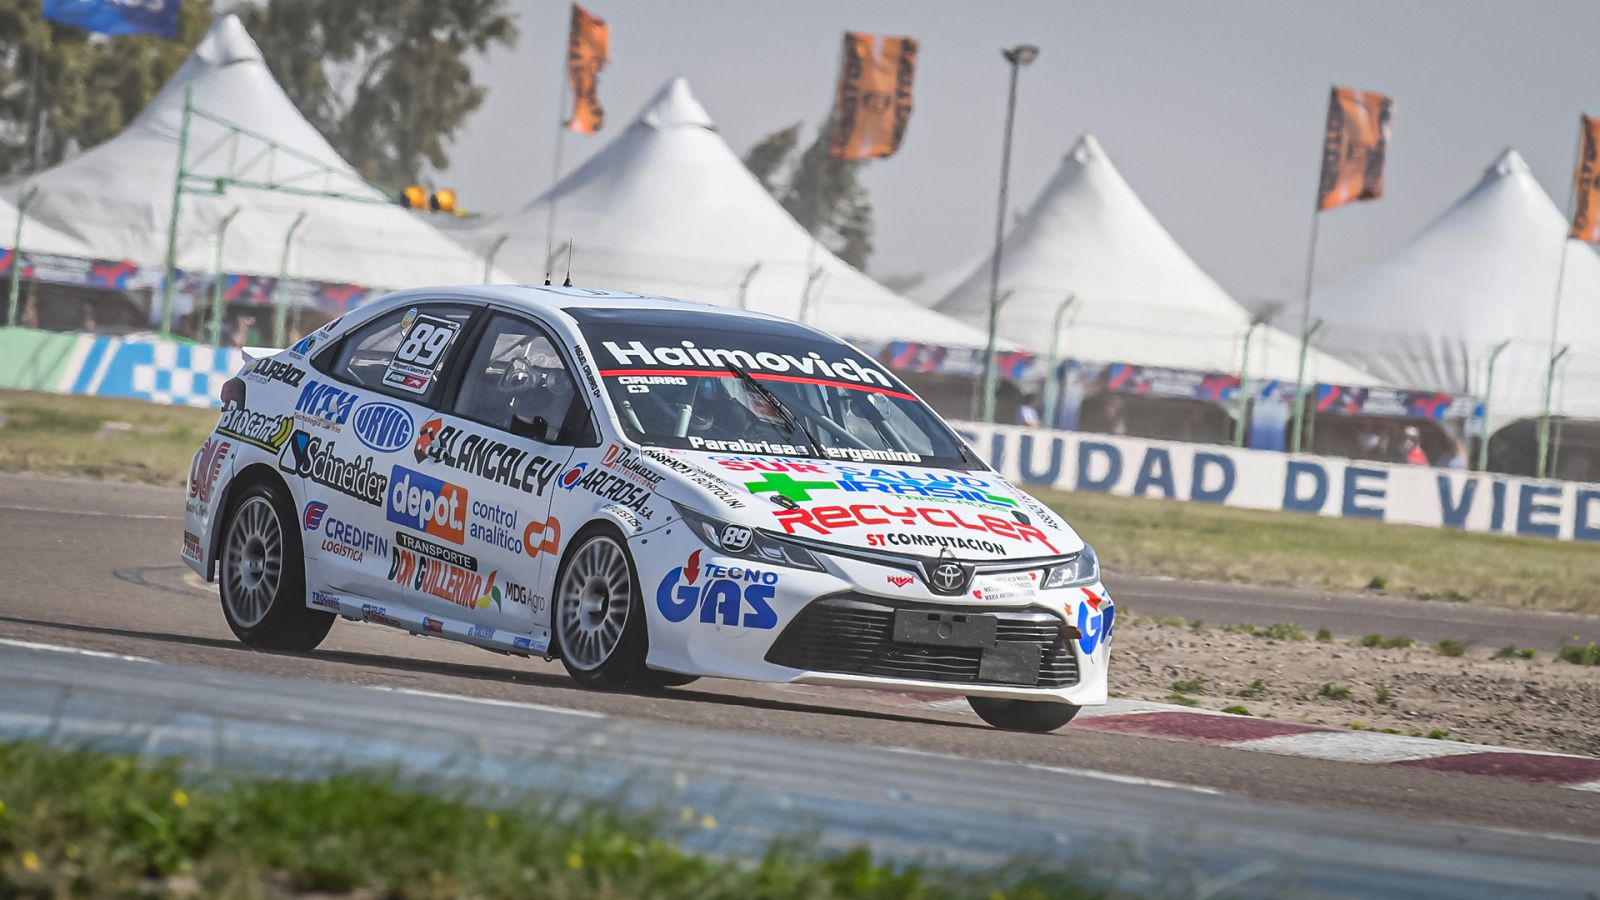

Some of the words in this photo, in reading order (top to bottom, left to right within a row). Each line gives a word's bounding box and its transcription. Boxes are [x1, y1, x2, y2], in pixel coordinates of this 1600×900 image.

[398, 323, 453, 365] 89
[602, 340, 893, 388] Haimovich
[627, 385, 650, 393] C3
[356, 403, 409, 447] URVIG
[434, 425, 560, 496] BLANCALEY
[615, 446, 666, 483] Dalmazzo
[688, 436, 810, 456] Parabrisas
[300, 437, 387, 501] Schneider
[717, 460, 830, 475] SUR
[834, 466, 991, 488] SALUD
[958, 428, 1238, 506] IUDAD
[1282, 461, 1389, 519] DE
[577, 468, 651, 513] ARCROSA
[472, 501, 518, 530] control
[325, 517, 388, 559] CREDIFIN
[401, 535, 471, 568] TRANSPORTE
[470, 522, 523, 554] analítico
[722, 527, 751, 548] 89
[387, 546, 415, 588] DON
[414, 556, 482, 610] GUILLERMO
[704, 563, 779, 585] TECNO
[656, 566, 778, 630] GAS
